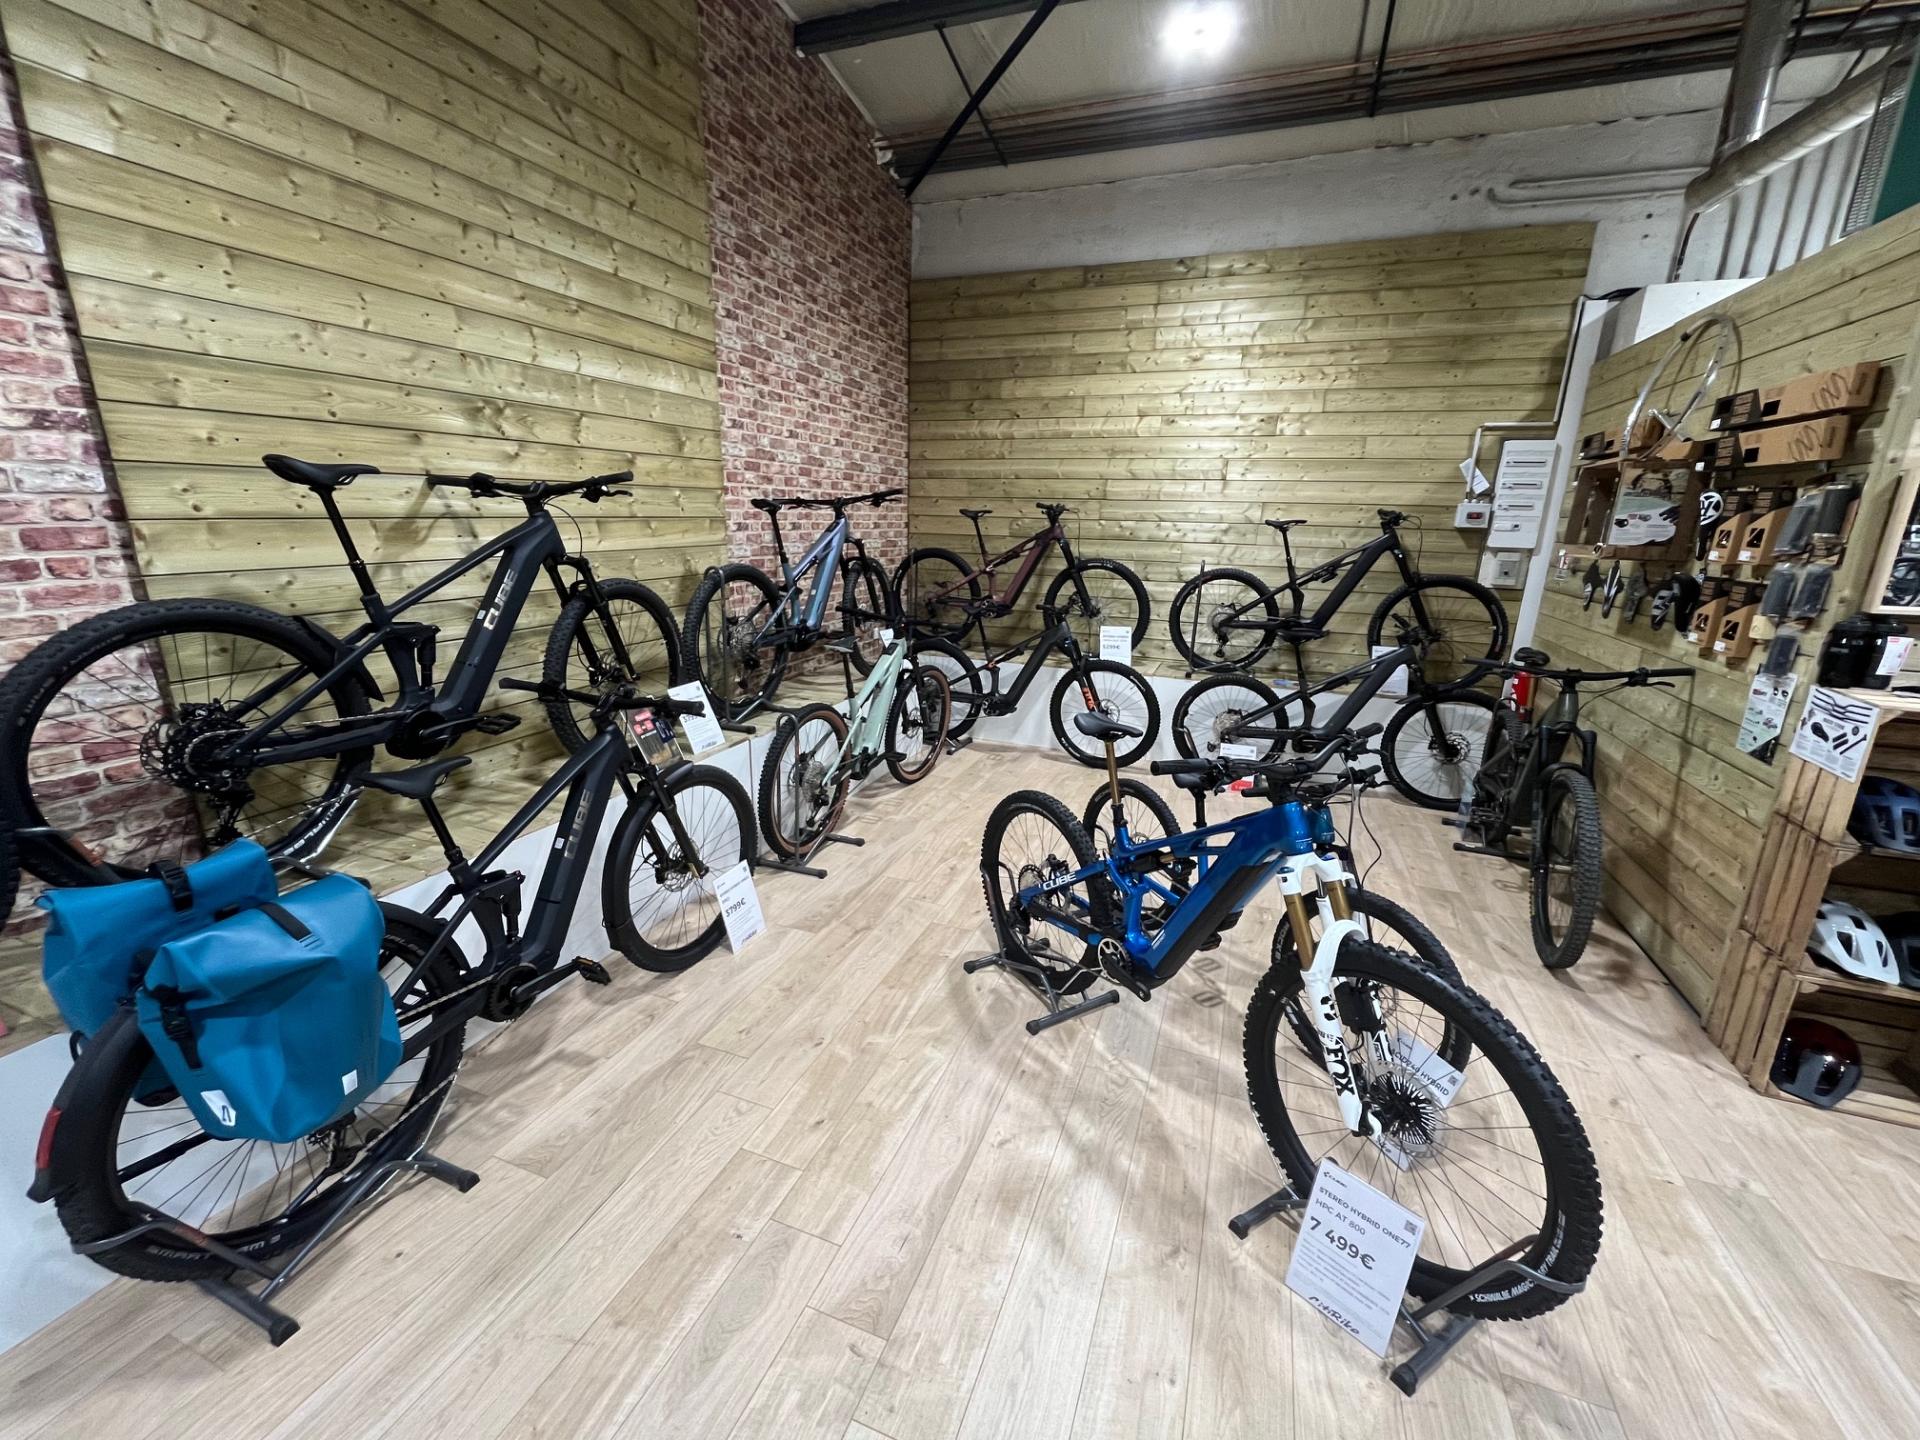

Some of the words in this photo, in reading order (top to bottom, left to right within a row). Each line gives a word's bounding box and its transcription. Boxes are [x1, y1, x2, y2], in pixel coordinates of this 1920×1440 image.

[483, 568, 518, 631] CUBE
[564, 789, 594, 860] CUBE
[1042, 870, 1078, 891] CUBE
[1324, 1045, 1357, 1098] FOX
[1420, 1071, 1450, 1096] HYBRID
[1310, 1215, 1322, 1231] 7
[1324, 1229, 1376, 1270] 499€
[1315, 1198, 1335, 1214] HPC
[1335, 1211, 1348, 1223] AT
[1348, 1220, 1366, 1236] 800
[1319, 1186, 1350, 1209] STEREO
[1350, 1207, 1381, 1230] HYBRID
[1382, 1227, 1412, 1249] ONE77
[1510, 1278, 1534, 1298] MAGIC
